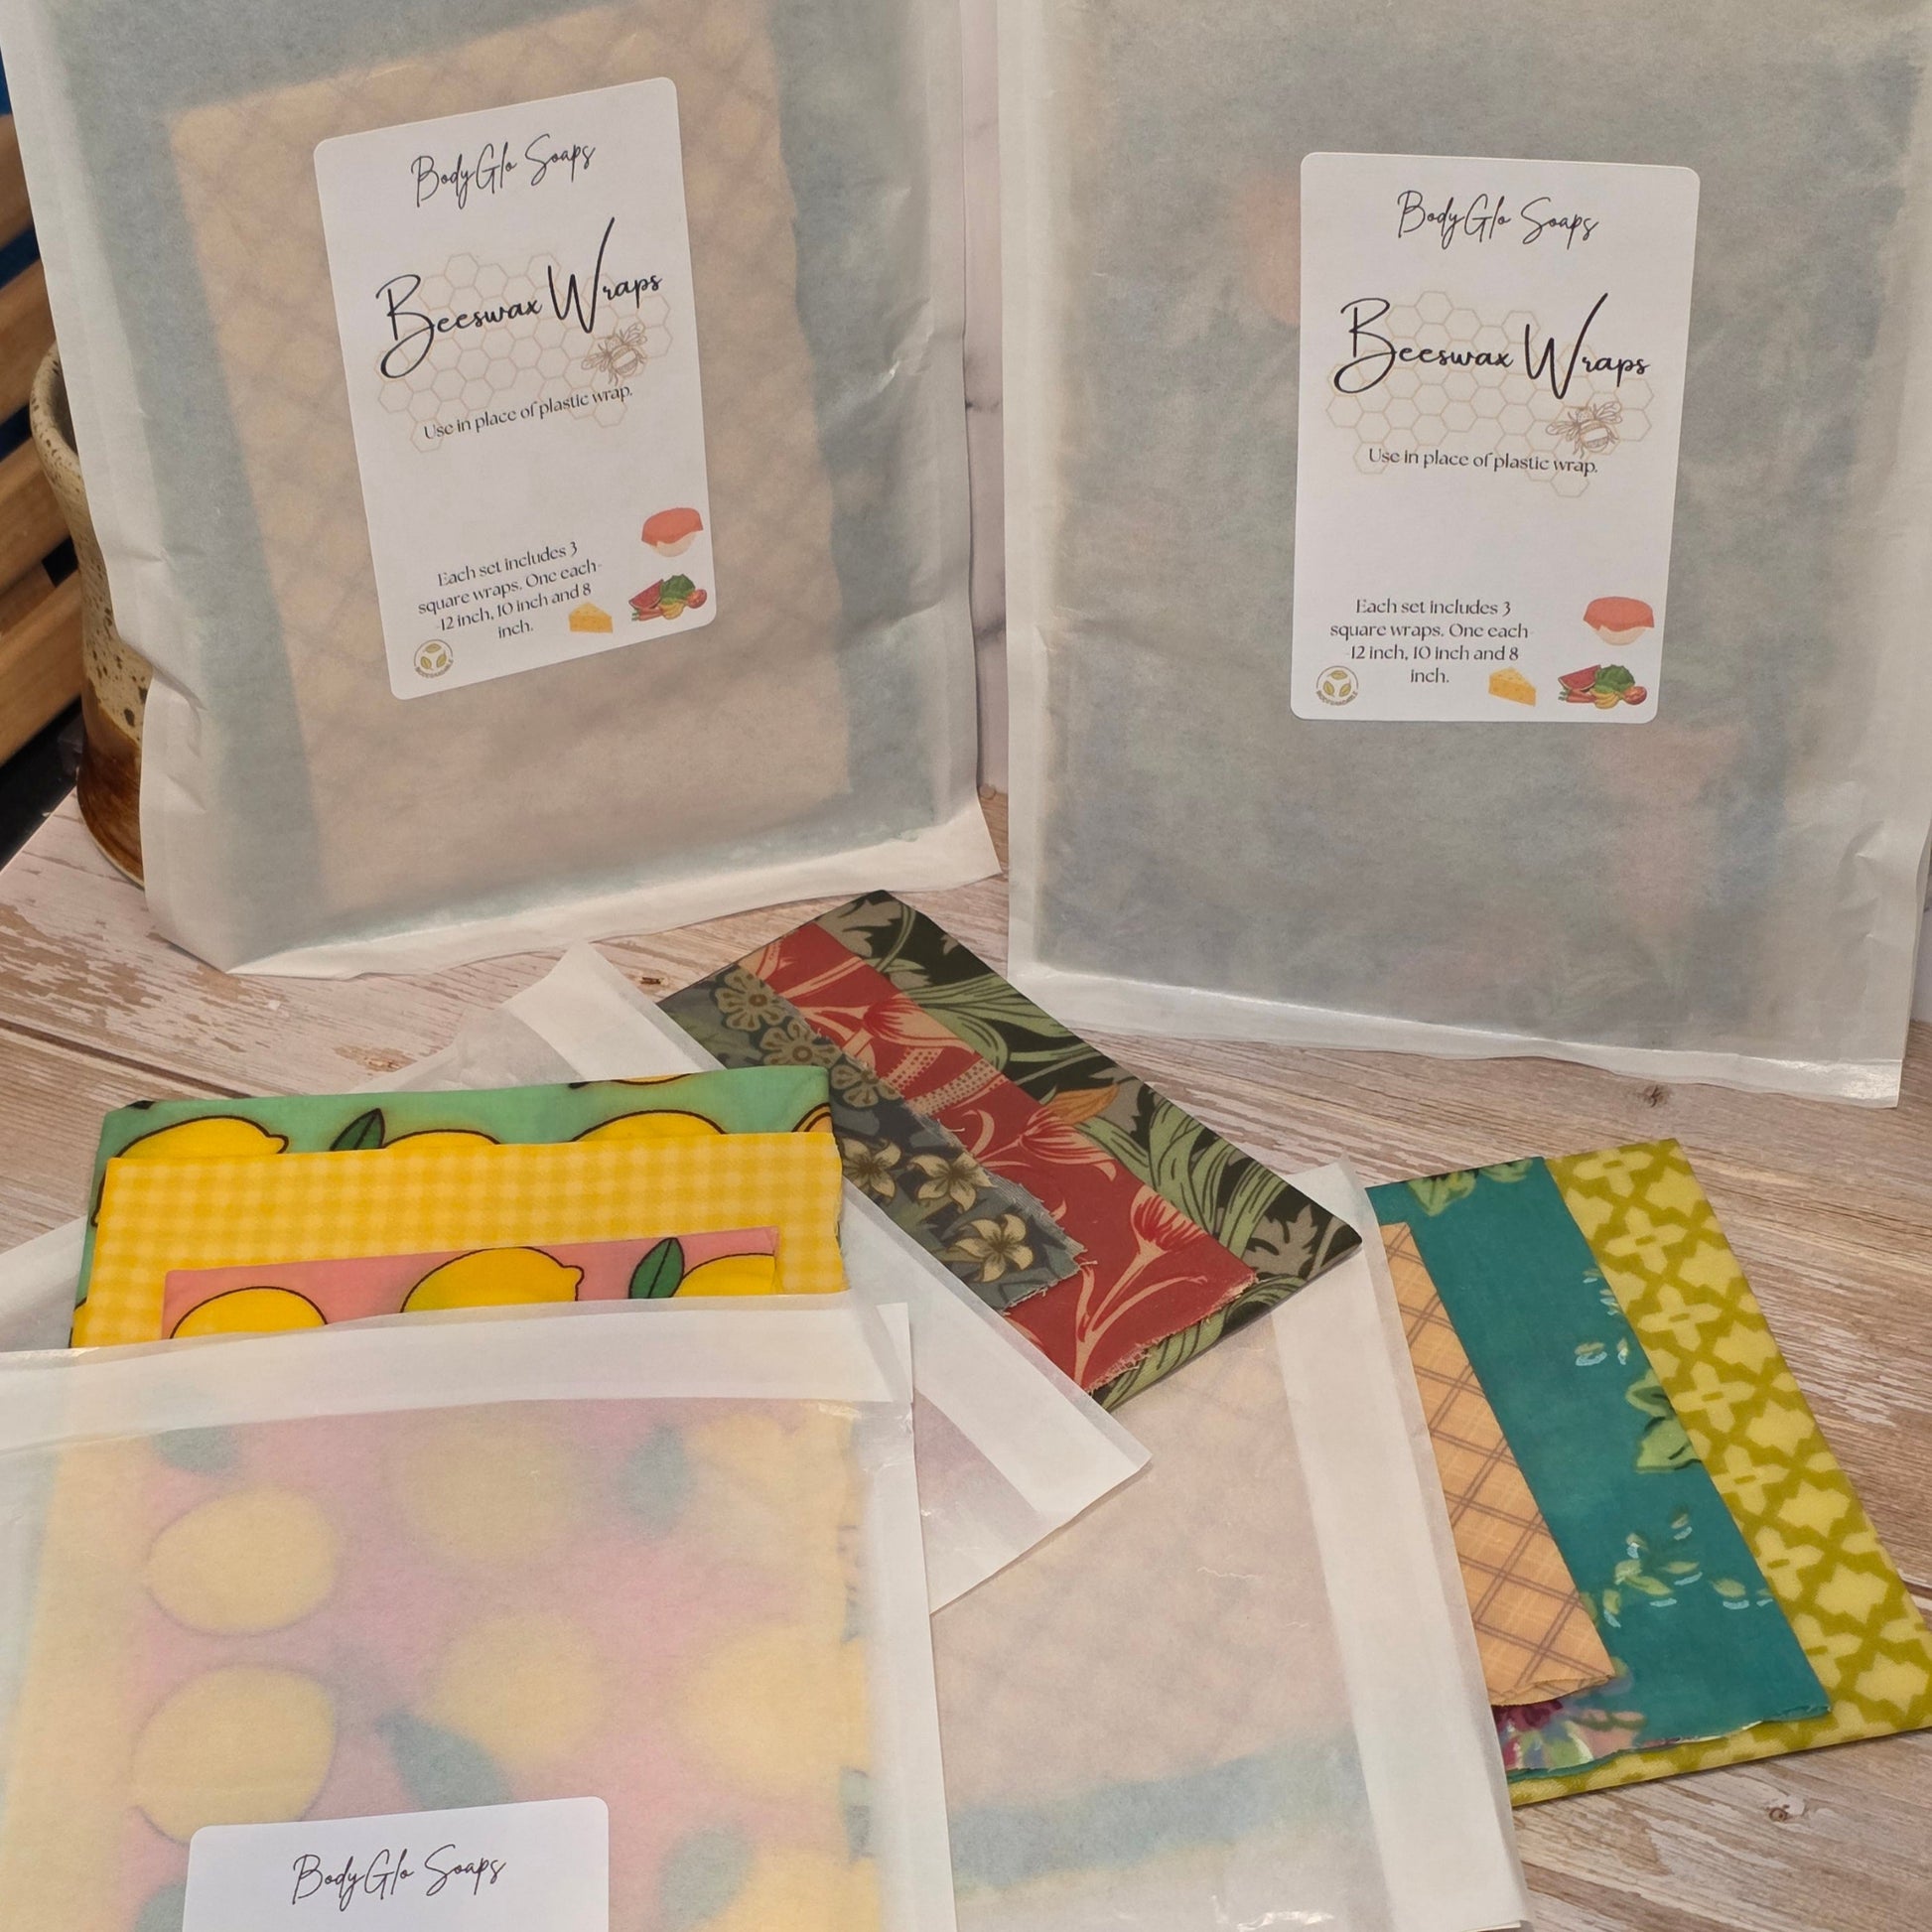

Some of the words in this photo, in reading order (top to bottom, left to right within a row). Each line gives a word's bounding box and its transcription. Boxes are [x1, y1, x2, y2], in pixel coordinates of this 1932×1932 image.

[524, 132, 597, 187] Soaps
[1520, 196, 1600, 250] Soaps
[375, 273, 543, 379] Beeswax
[547, 216, 663, 335] Wraps
[1333, 297, 1515, 394] Beeswax
[1524, 292, 1651, 400] Wraps
[424, 422, 456, 440] Use
[457, 417, 472, 434] in
[475, 409, 517, 433] place
[520, 401, 536, 418] of
[538, 392, 590, 419] plastic
[592, 384, 633, 405] wrap.
[1368, 447, 1401, 464] Use
[1404, 449, 1419, 465] in
[1423, 449, 1469, 470] place
[1472, 451, 1490, 468] of
[1493, 453, 1550, 472] plastic
[1552, 458, 1599, 479] wrap.
[437, 565, 476, 587] Each
[479, 561, 502, 577] set
[504, 545, 567, 571] includes
[570, 541, 578, 557] 3
[417, 593, 471, 616] square
[473, 580, 523, 602] wraps.
[525, 572, 557, 588] One
[457, 607, 494, 627] inch,
[496, 602, 513, 618] 10
[516, 593, 549, 612] inch
[551, 584, 580, 604] and
[582, 582, 592, 596] 8
[1355, 598, 1397, 615] Each
[1401, 600, 1426, 615] set
[1430, 599, 1498, 616] includes
[1502, 601, 1511, 617] 3
[497, 620, 534, 639] inch.
[1329, 624, 1387, 640] square
[1390, 625, 1445, 640] wraps.
[1449, 622, 1484, 637] One
[1369, 643, 1409, 661] inch,
[1413, 645, 1431, 660] 10
[1435, 644, 1469, 661] inch
[1473, 645, 1505, 661] and
[1509, 646, 1519, 661] 8
[1410, 666, 1449, 684] inch.
[423, 1843, 506, 1897] Soaps
